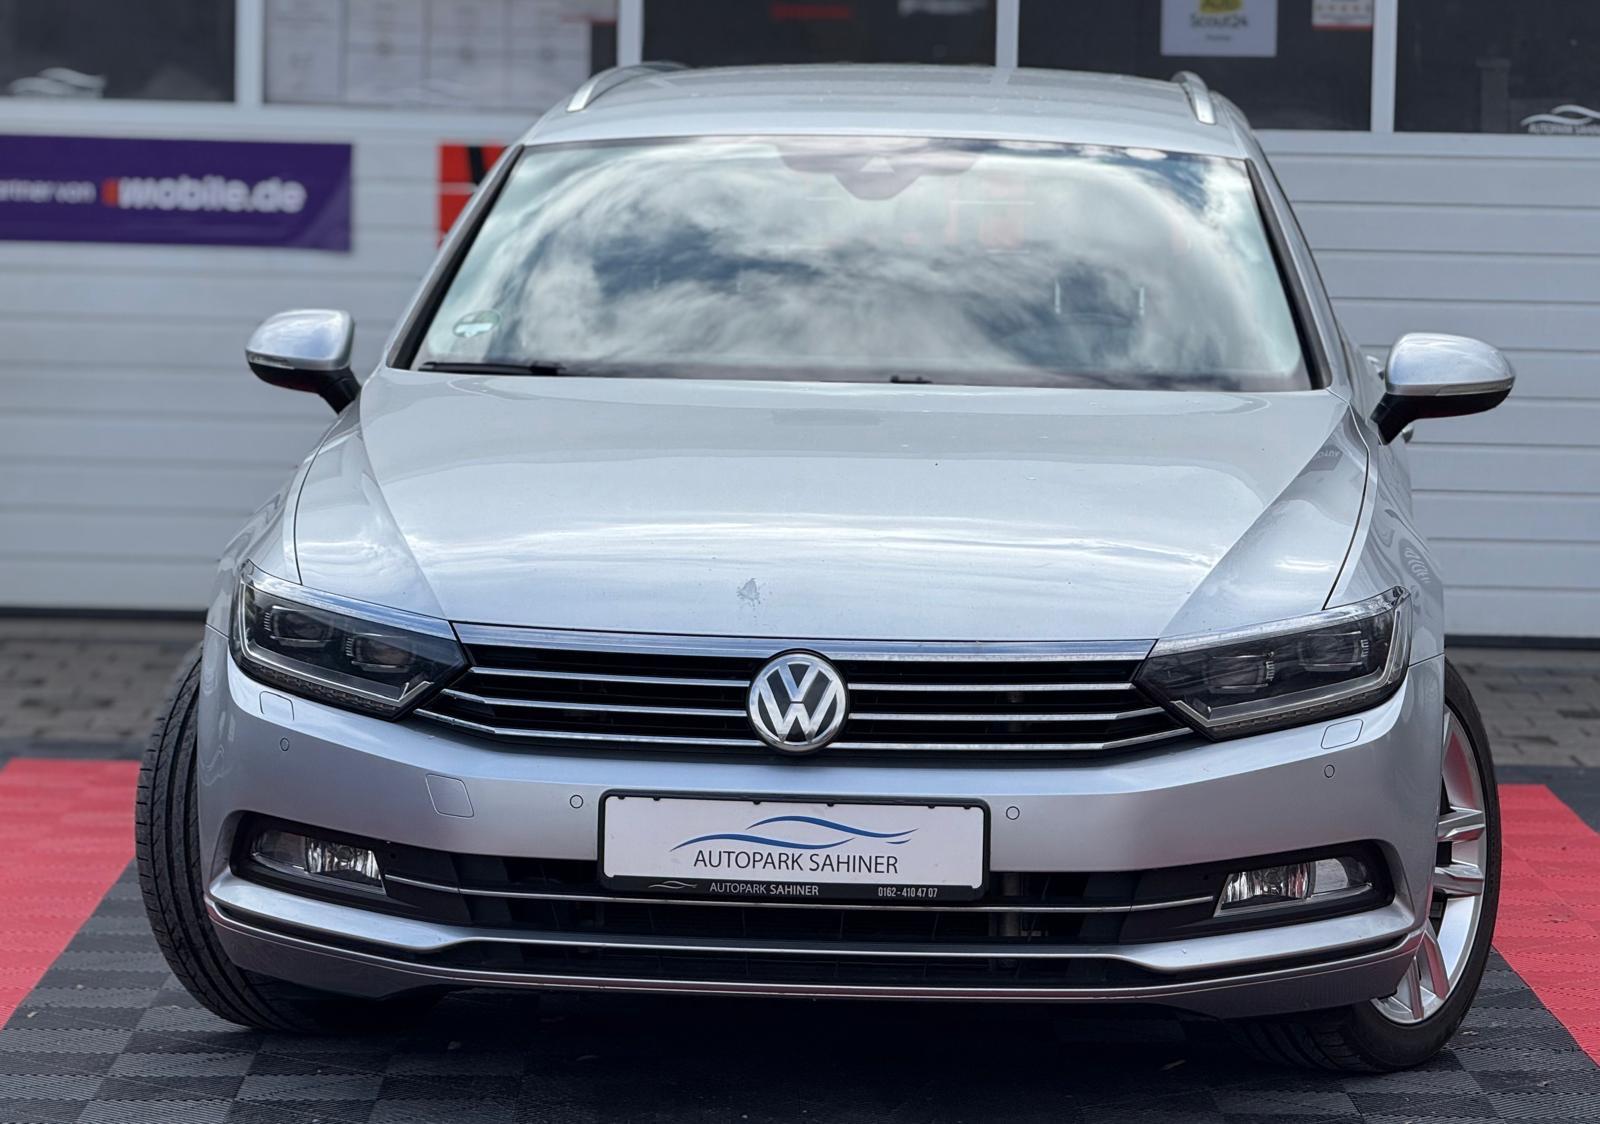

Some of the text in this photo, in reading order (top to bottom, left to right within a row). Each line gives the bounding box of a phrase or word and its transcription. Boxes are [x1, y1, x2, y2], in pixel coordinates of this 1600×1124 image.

[117, 174, 308, 214] mobile.de
[693, 850, 899, 874] AUTOPARK SAHINER
[709, 882, 819, 896] AUTOPARK SAHINER
